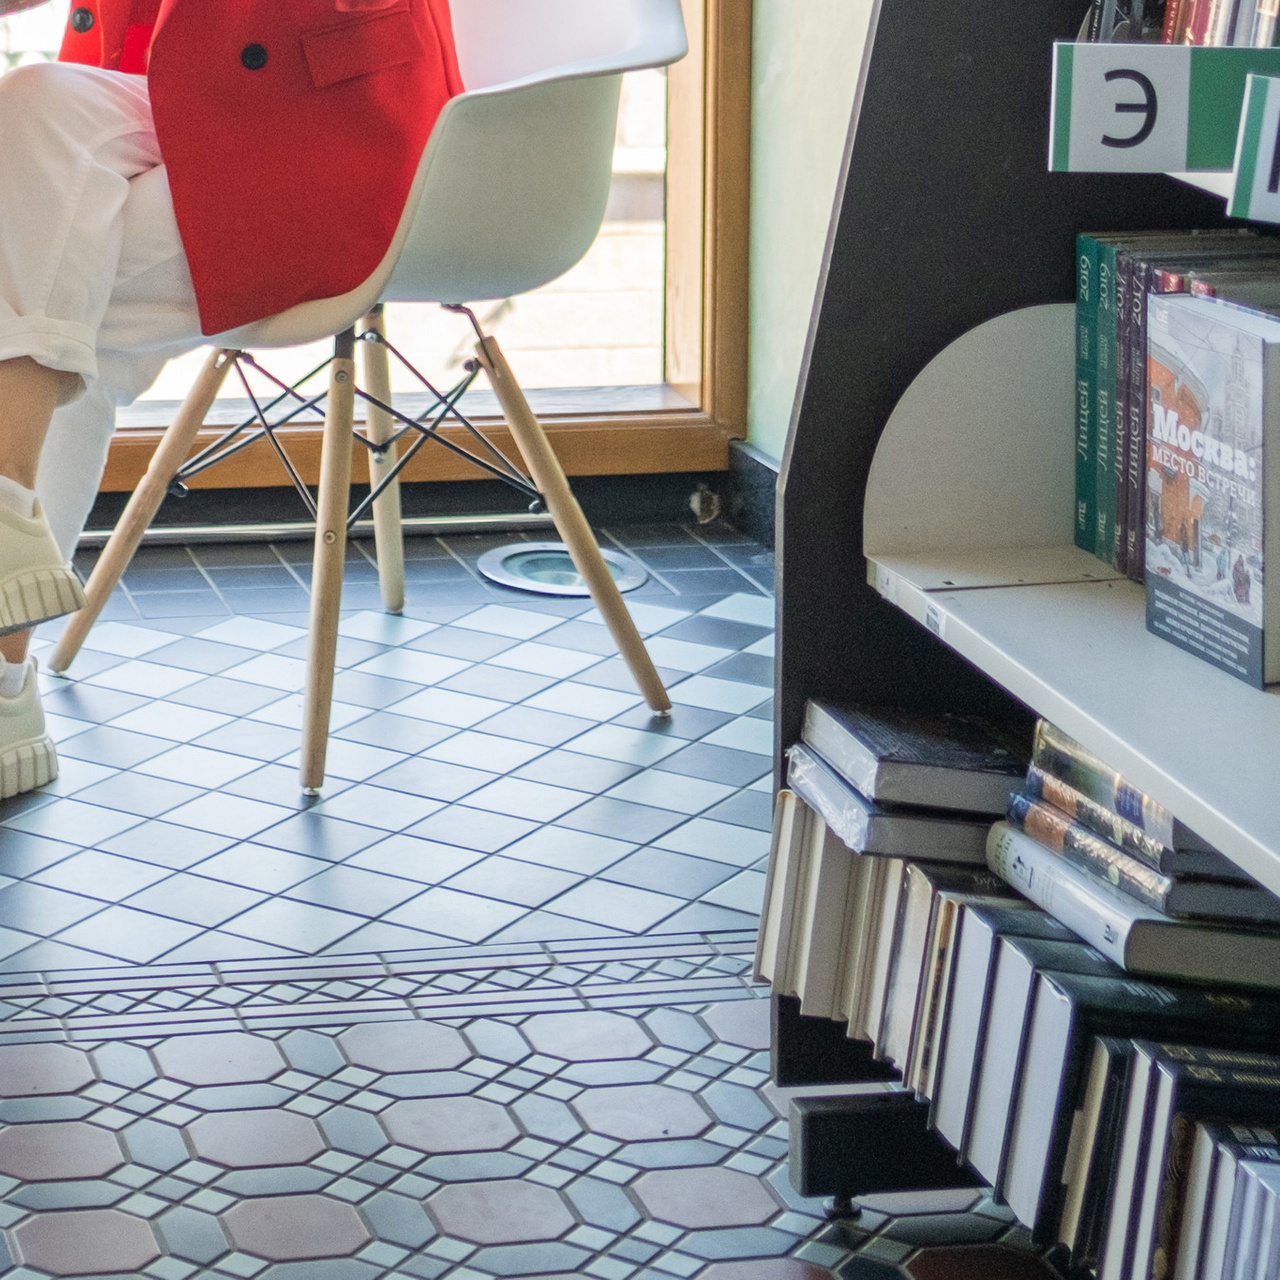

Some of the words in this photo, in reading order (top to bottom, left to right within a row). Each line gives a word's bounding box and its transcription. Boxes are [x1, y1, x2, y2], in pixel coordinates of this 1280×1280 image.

[1100, 69, 1158, 148] Э
[1080, 255, 1091, 301] 2019
[1100, 262, 1111, 311] 2019
[1132, 275, 1144, 327] 2017
[1077, 380, 1089, 461] Лицей
[1097, 389, 1109, 472] Лицей
[1129, 406, 1142, 489] Лицей
[1152, 404, 1257, 482] Москва:
[1152, 444, 1195, 478] МЕСТО
[1198, 459, 1257, 507] ВСТРЕЧИ
